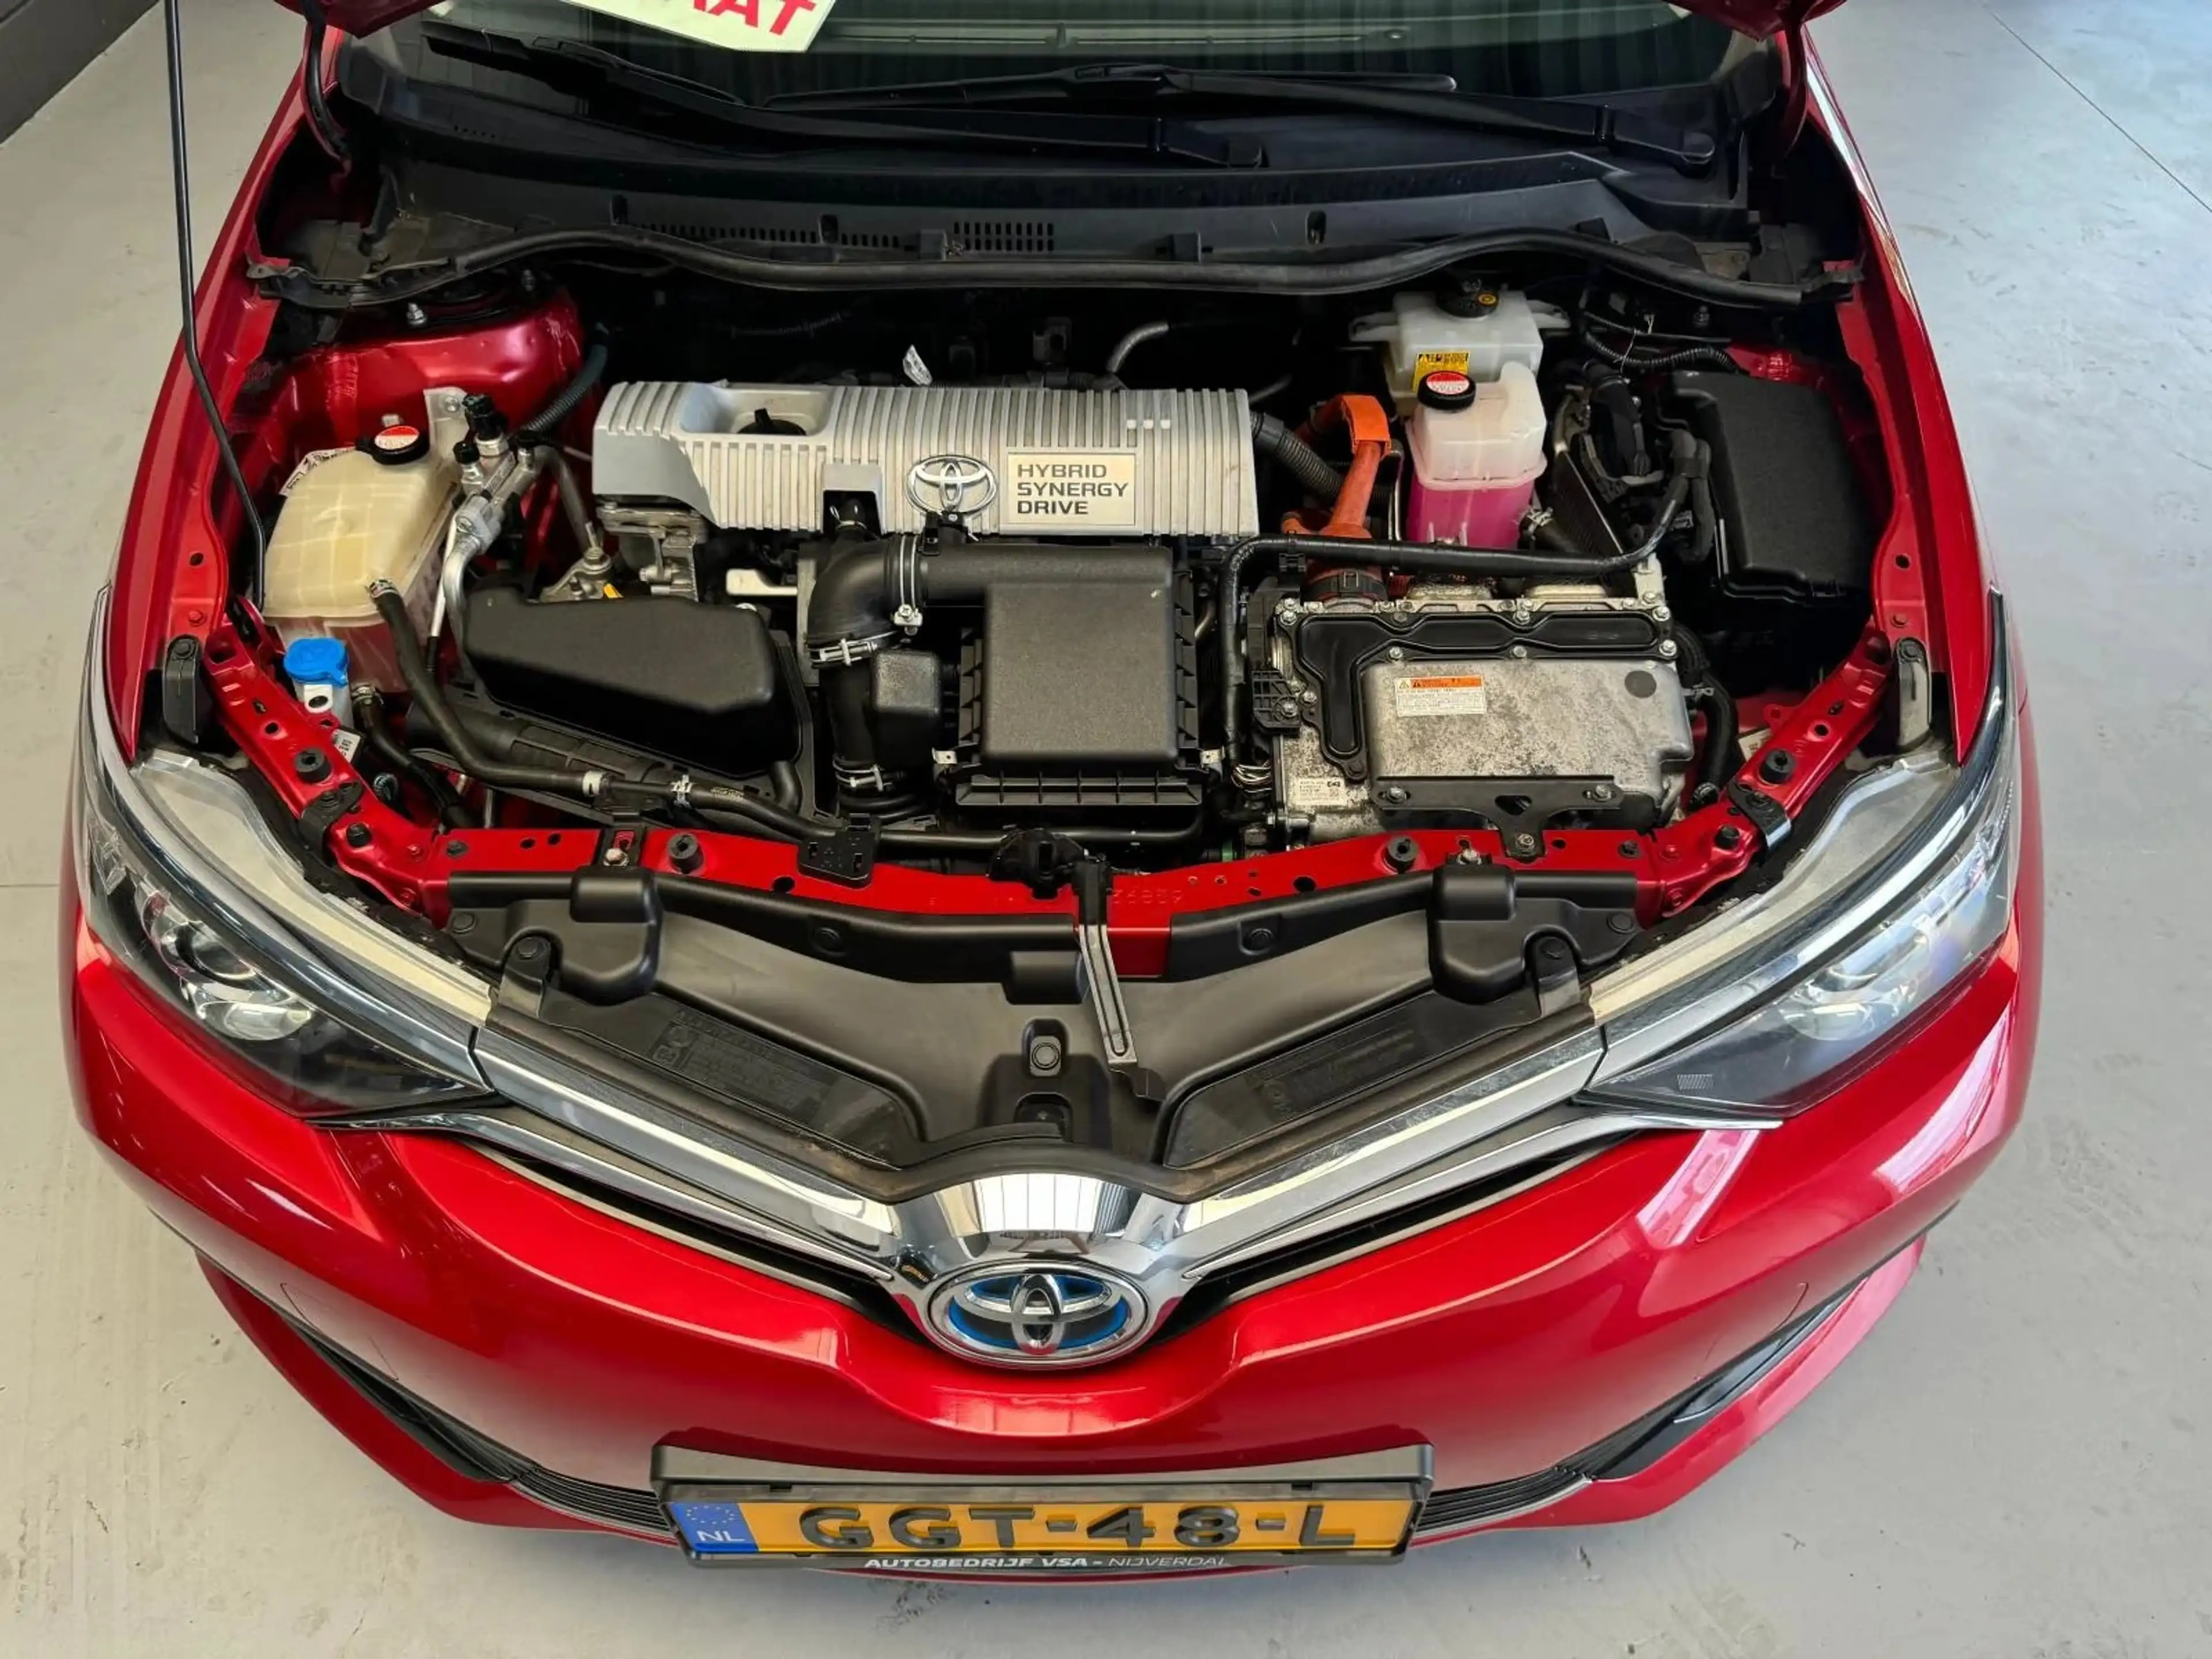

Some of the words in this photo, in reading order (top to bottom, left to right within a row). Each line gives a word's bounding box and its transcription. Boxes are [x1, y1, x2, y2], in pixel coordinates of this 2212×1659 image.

[694, 0, 816, 35] AT
[1017, 464, 1107, 478] HYBRID
[1017, 482, 1128, 497] SYNERGY
[1017, 501, 1089, 514] DRIVE
[800, 1505, 1355, 1549] GGT-48-L
[696, 1530, 745, 1541] NL
[864, 1558, 1034, 1568] AUTOBEDRIJF
[1041, 1557, 1088, 1567] VSA
[1108, 1556, 1229, 1567] NIJVERDAL
